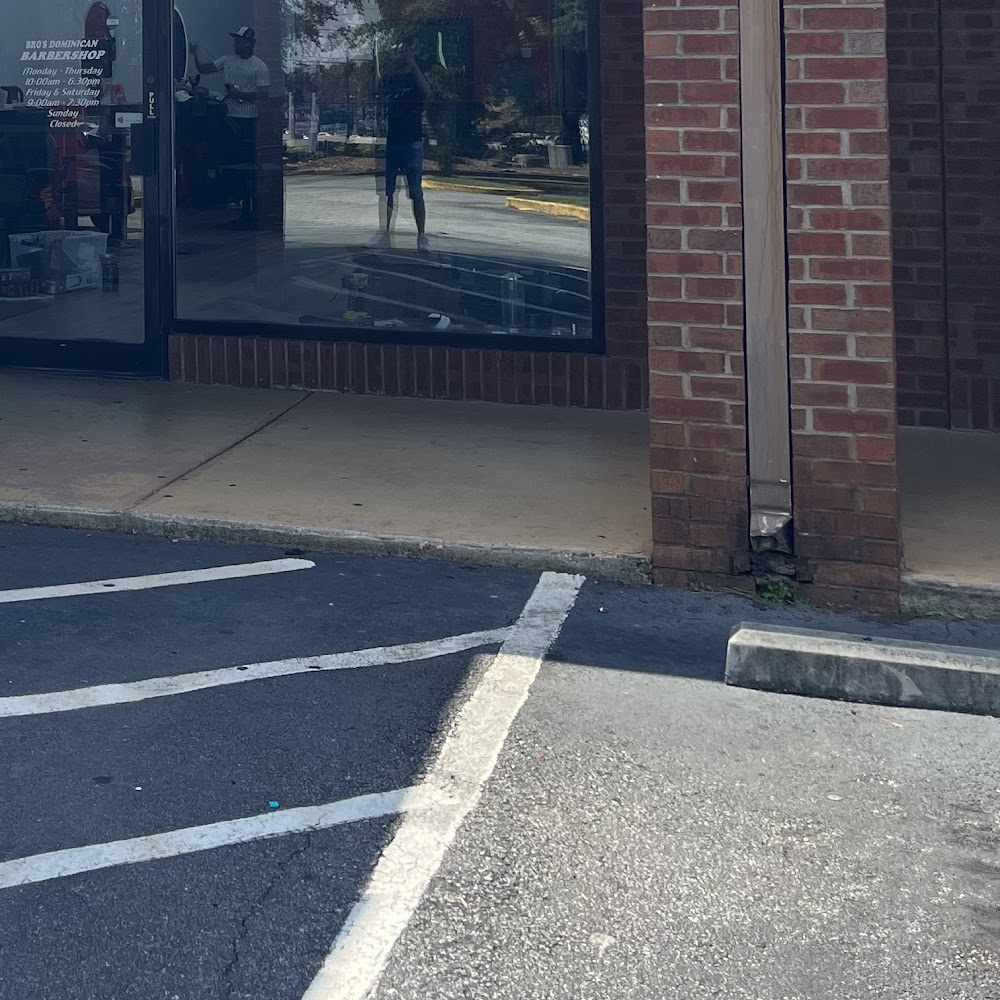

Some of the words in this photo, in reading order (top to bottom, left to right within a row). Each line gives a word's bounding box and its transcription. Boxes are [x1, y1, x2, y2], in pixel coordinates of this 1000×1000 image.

[49, 39, 99, 49] DOMINICAN
[20, 50, 105, 60] BARBERSHOP
[22, 67, 58, 77] Monday
[64, 66, 104, 77] Thursday
[25, 88, 53, 98] Friday
[53, 88, 60, 96] &
[61, 87, 101, 98] Saturday
[47, 109, 80, 119] Sunday
[49, 119, 79, 128] Closed
